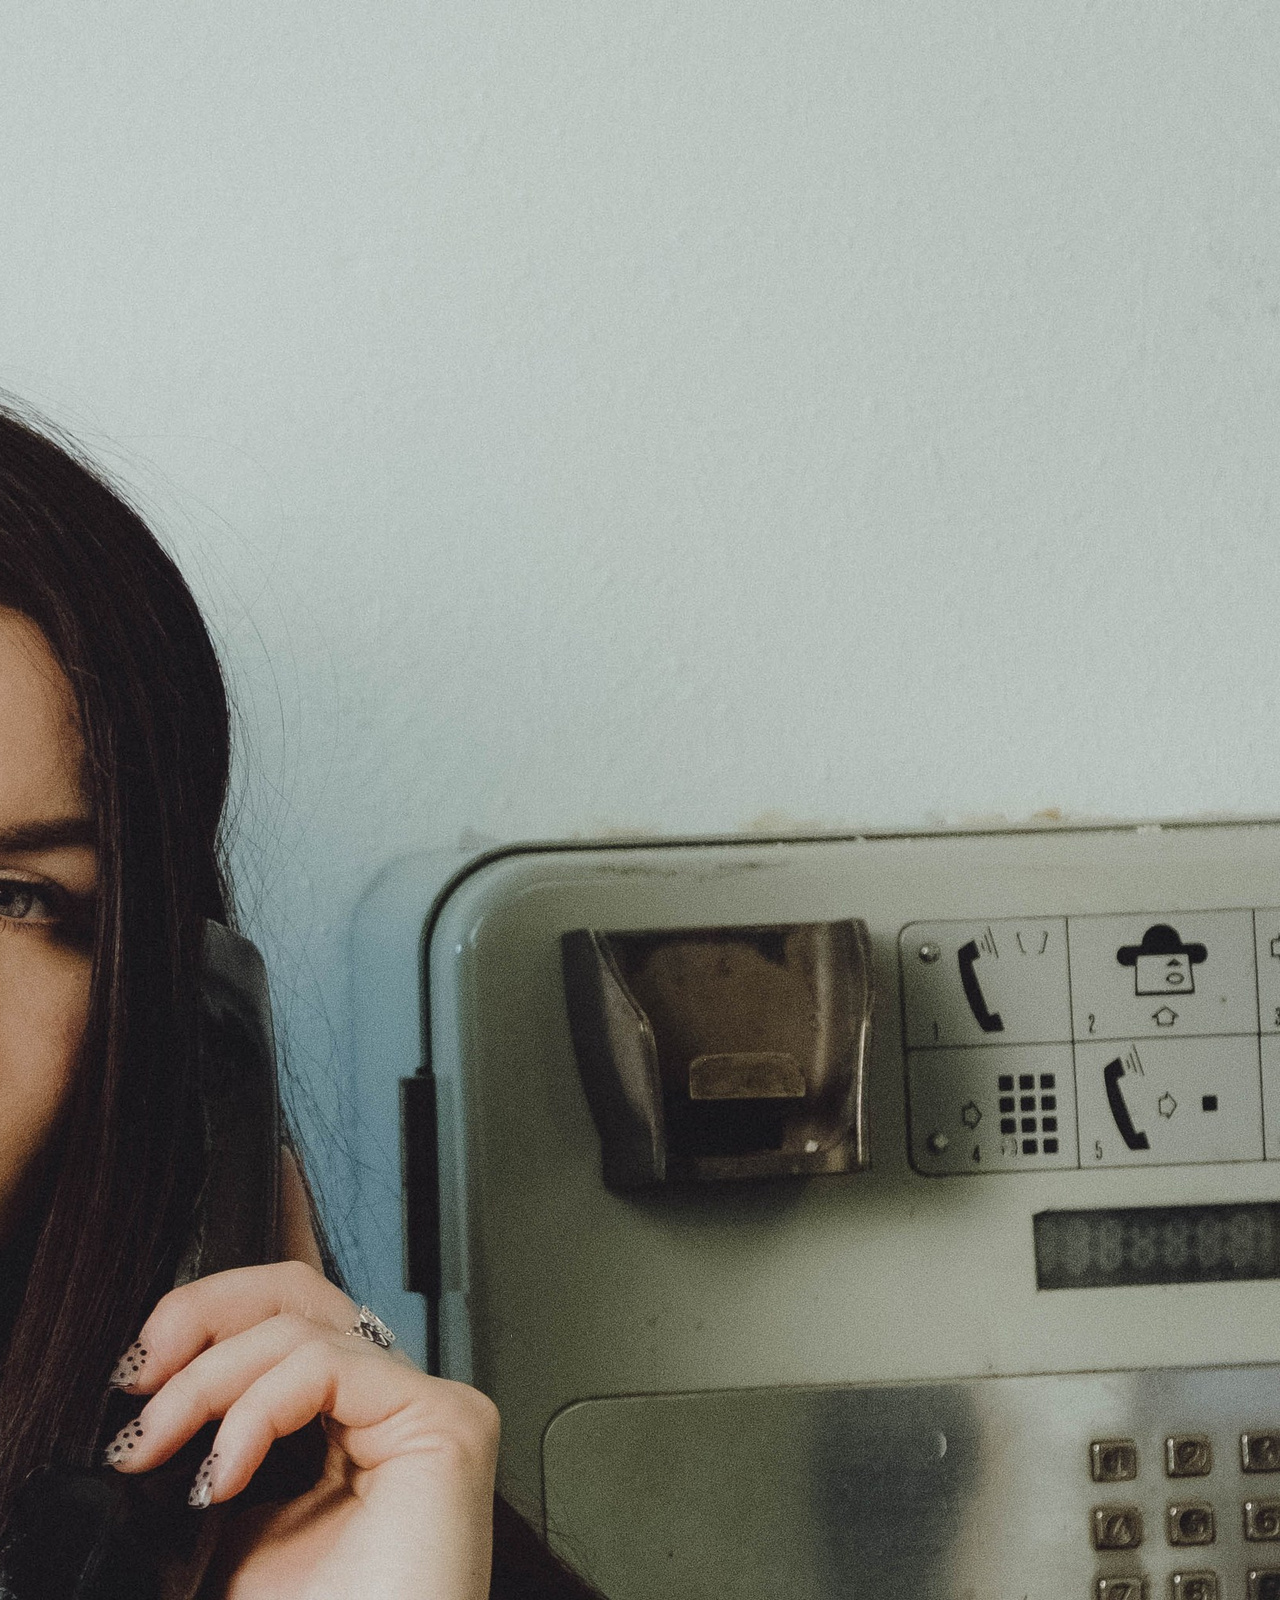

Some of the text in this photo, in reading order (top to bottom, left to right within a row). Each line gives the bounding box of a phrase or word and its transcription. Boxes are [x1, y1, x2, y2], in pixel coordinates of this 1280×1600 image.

[932, 1021, 939, 1041] 1
[1088, 1013, 1096, 1034] 2
[972, 1144, 981, 1163] 4
[1094, 1140, 1103, 1160] 5
